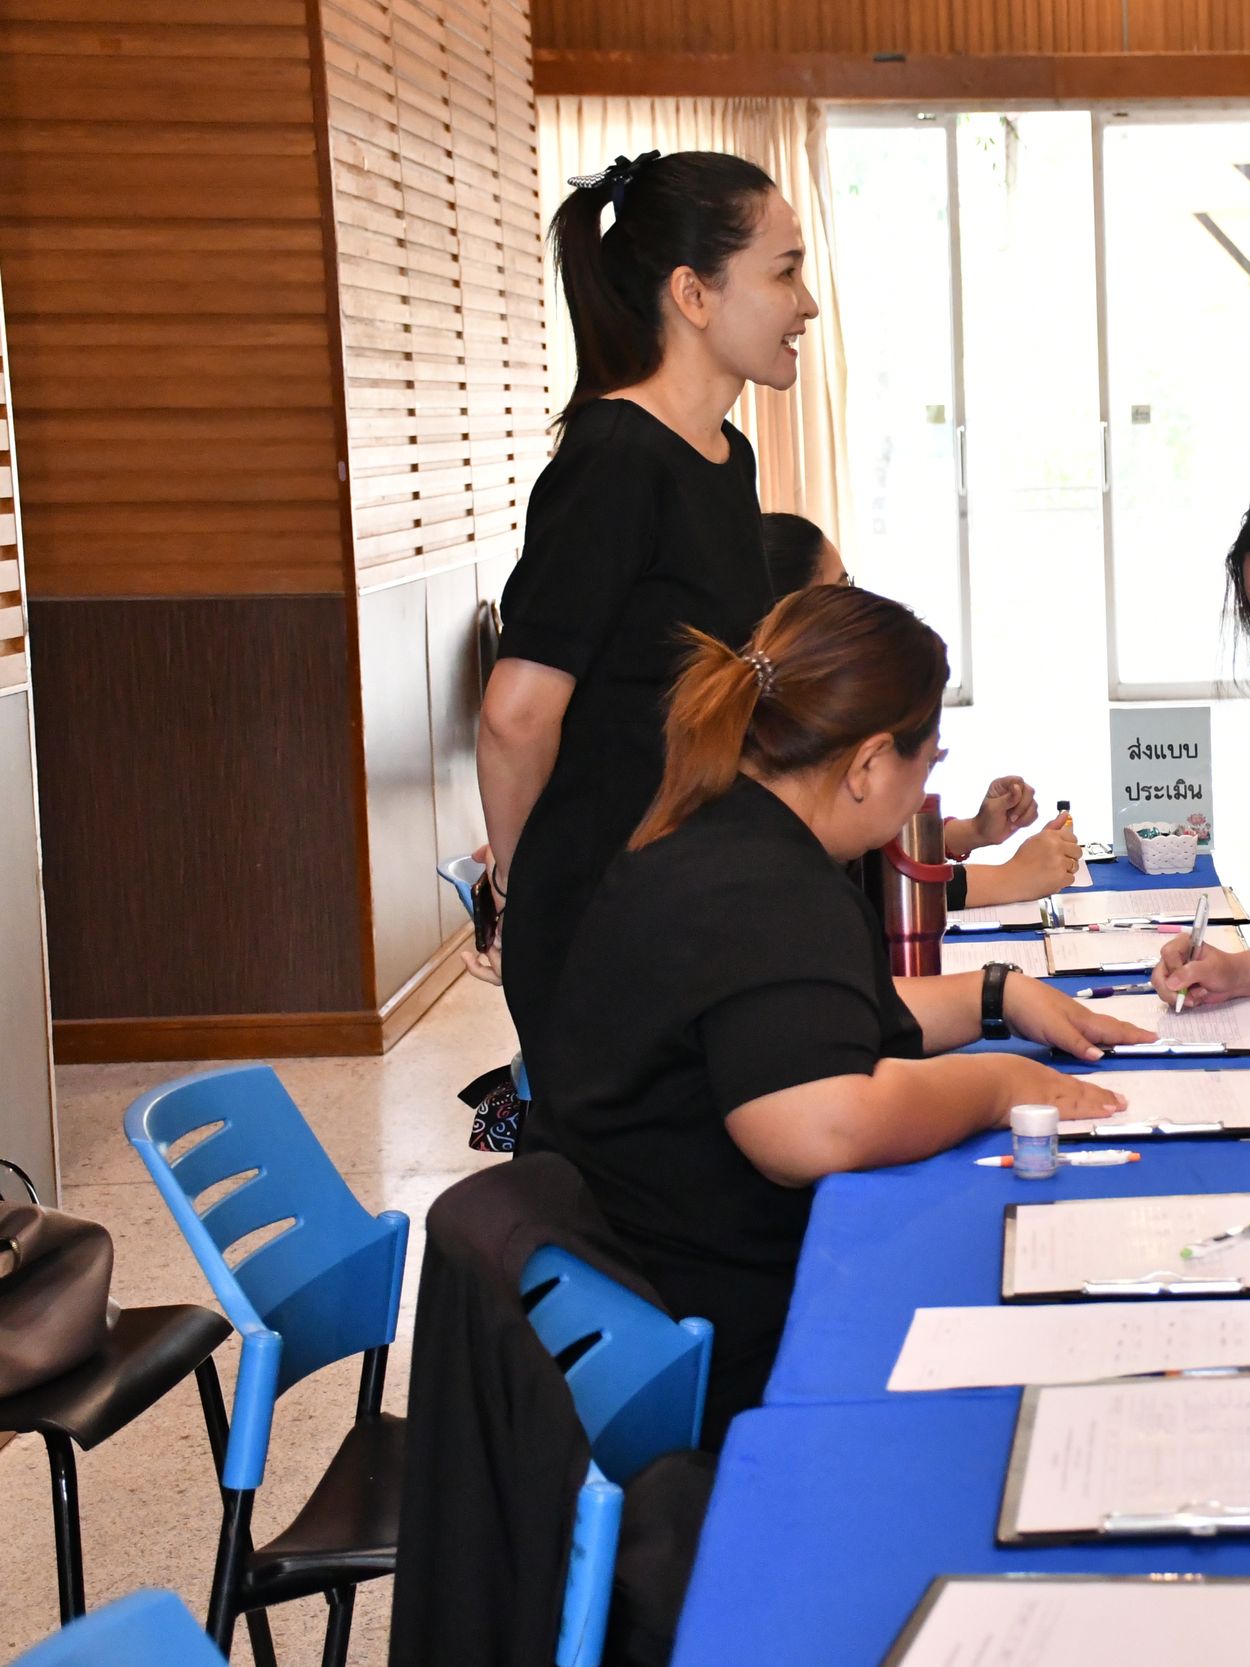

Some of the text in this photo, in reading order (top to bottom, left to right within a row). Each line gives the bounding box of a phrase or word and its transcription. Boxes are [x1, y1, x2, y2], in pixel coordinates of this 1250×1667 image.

[1127, 736, 1198, 760] ส่งแบบ
[1125, 778, 1203, 801] ประเมิน
